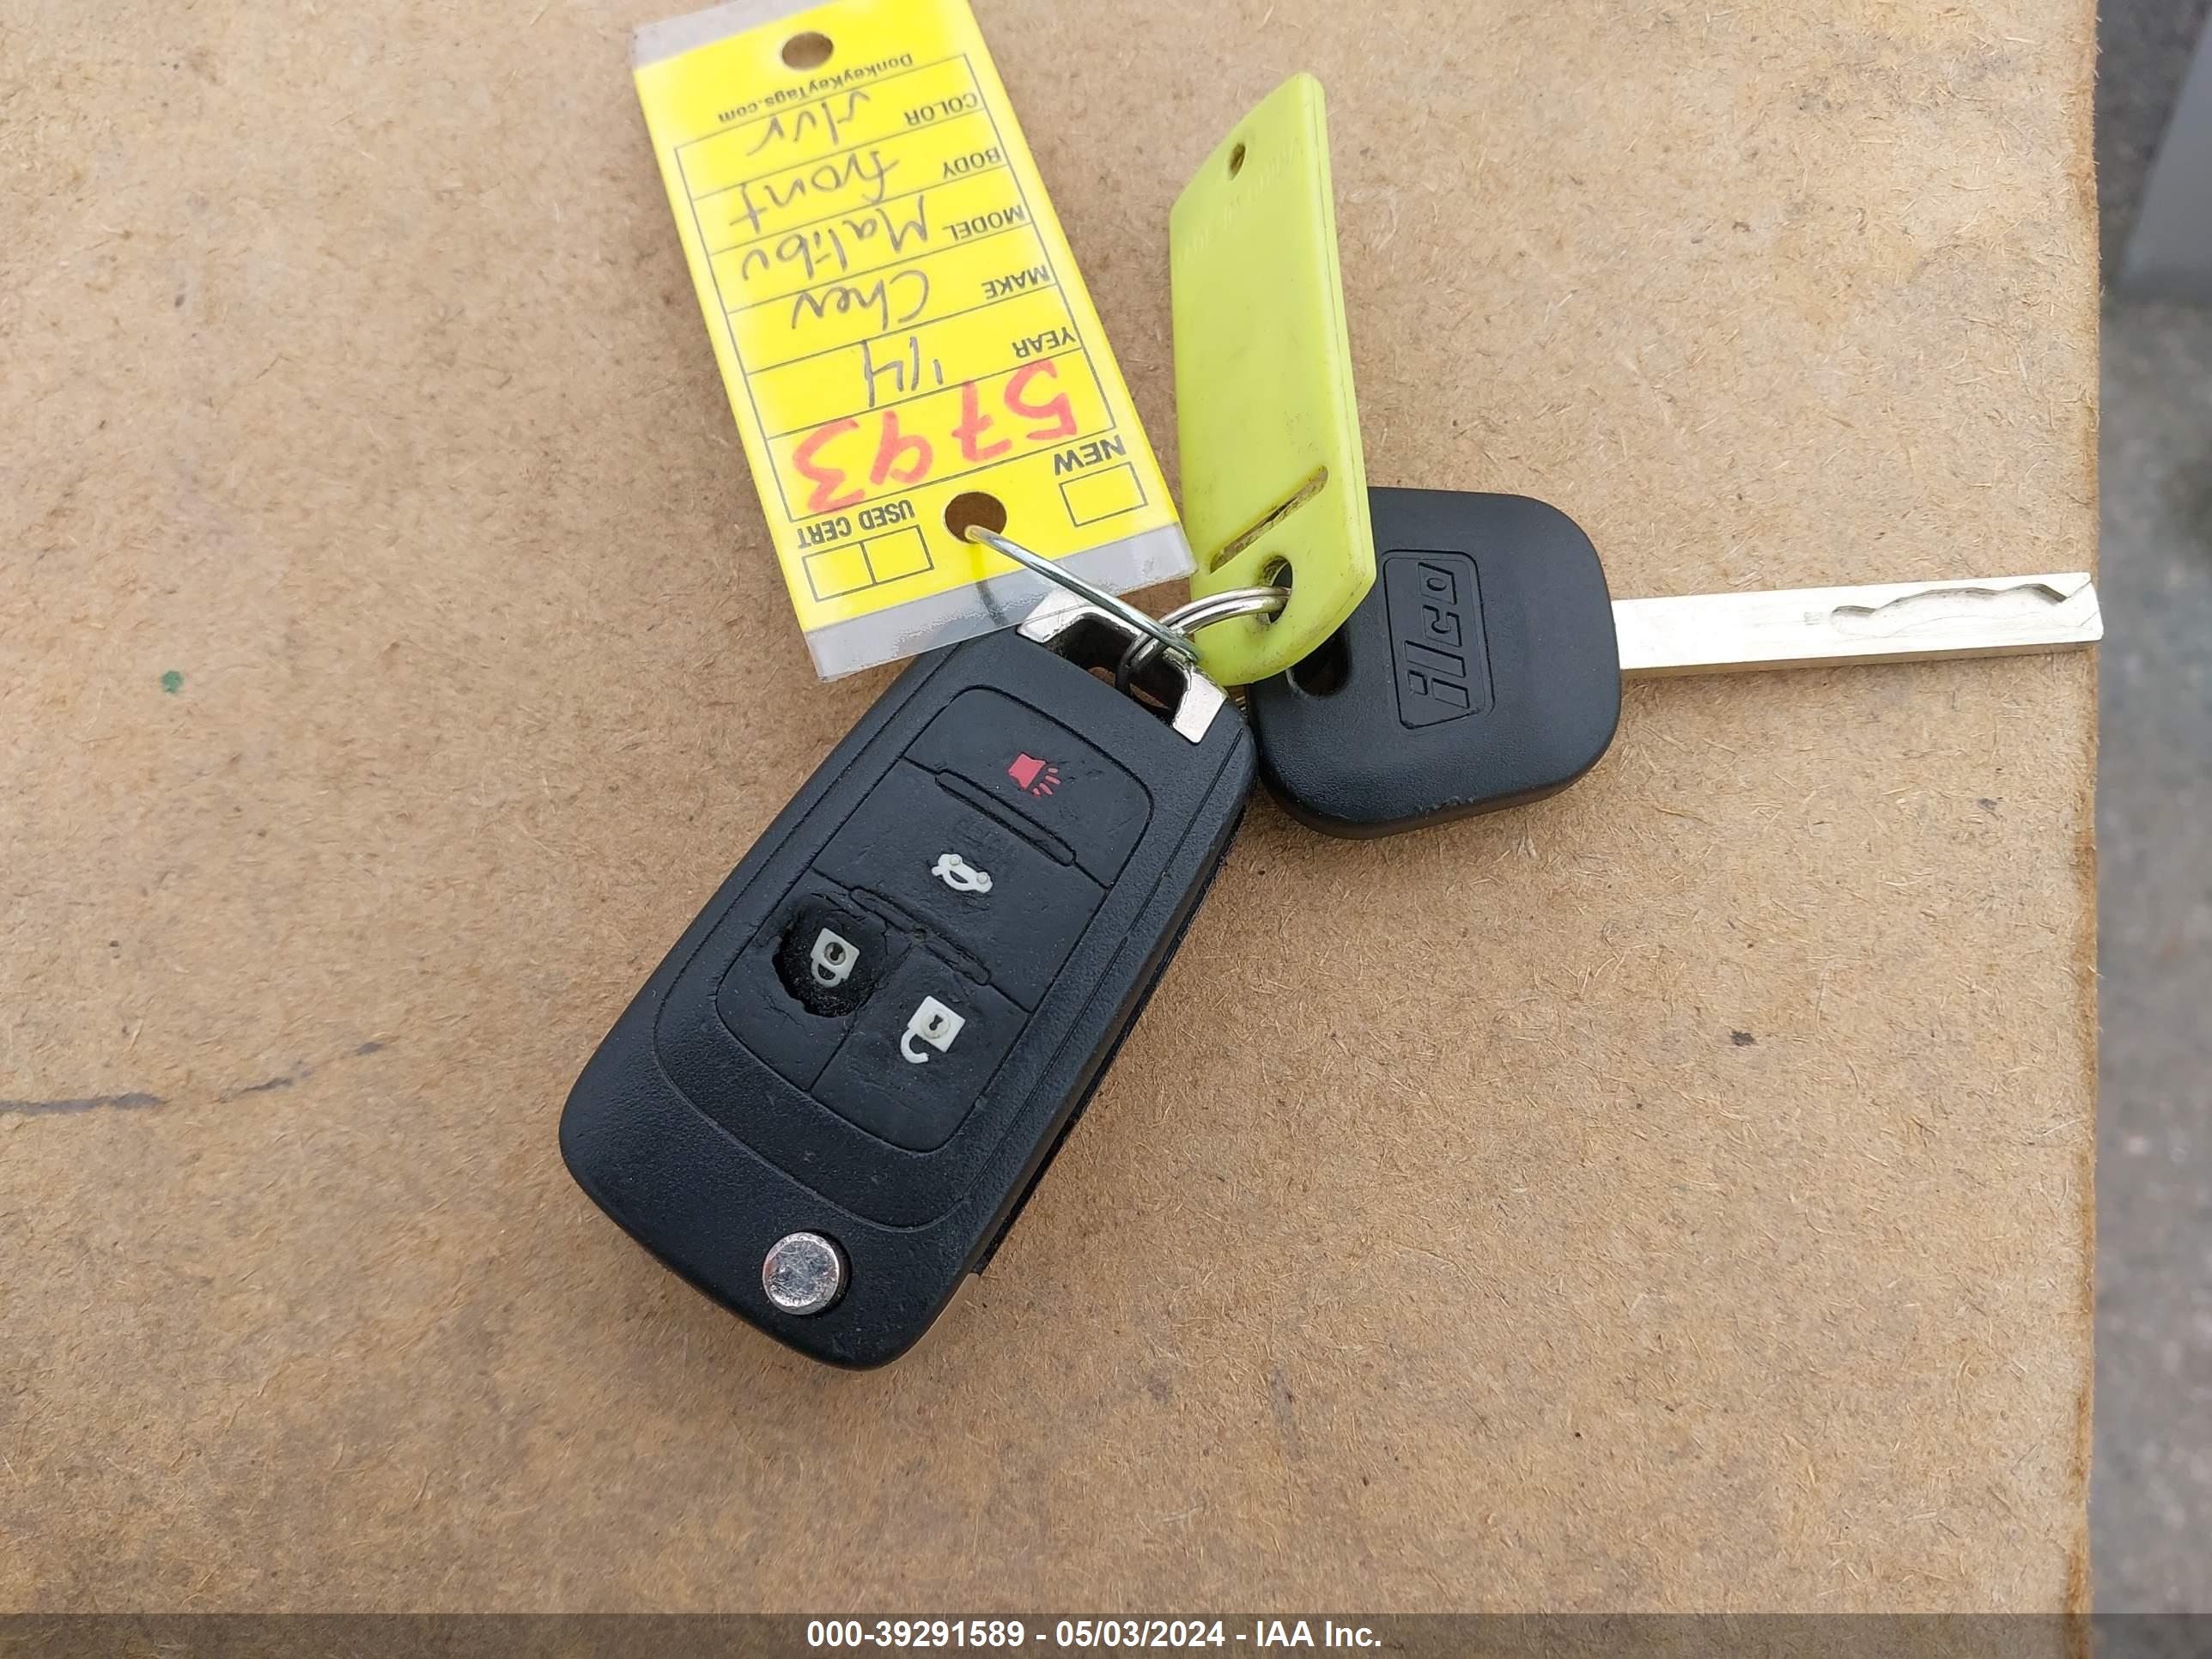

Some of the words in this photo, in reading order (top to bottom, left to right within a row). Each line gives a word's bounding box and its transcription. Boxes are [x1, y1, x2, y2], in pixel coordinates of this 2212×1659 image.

[718, 52, 914, 124] DonkeyKeyTags.com
[904, 91, 979, 128] COLOR
[942, 145, 1002, 179] BODY
[730, 149, 901, 234] front
[942, 204, 1024, 243] MODEL
[981, 264, 1050, 301] MAKE
[1012, 325, 1077, 359] YEAR
[792, 359, 1079, 514] 5793
[1053, 434, 1127, 476] NEW
[858, 498, 916, 531] USED
[797, 519, 853, 550] CERT
